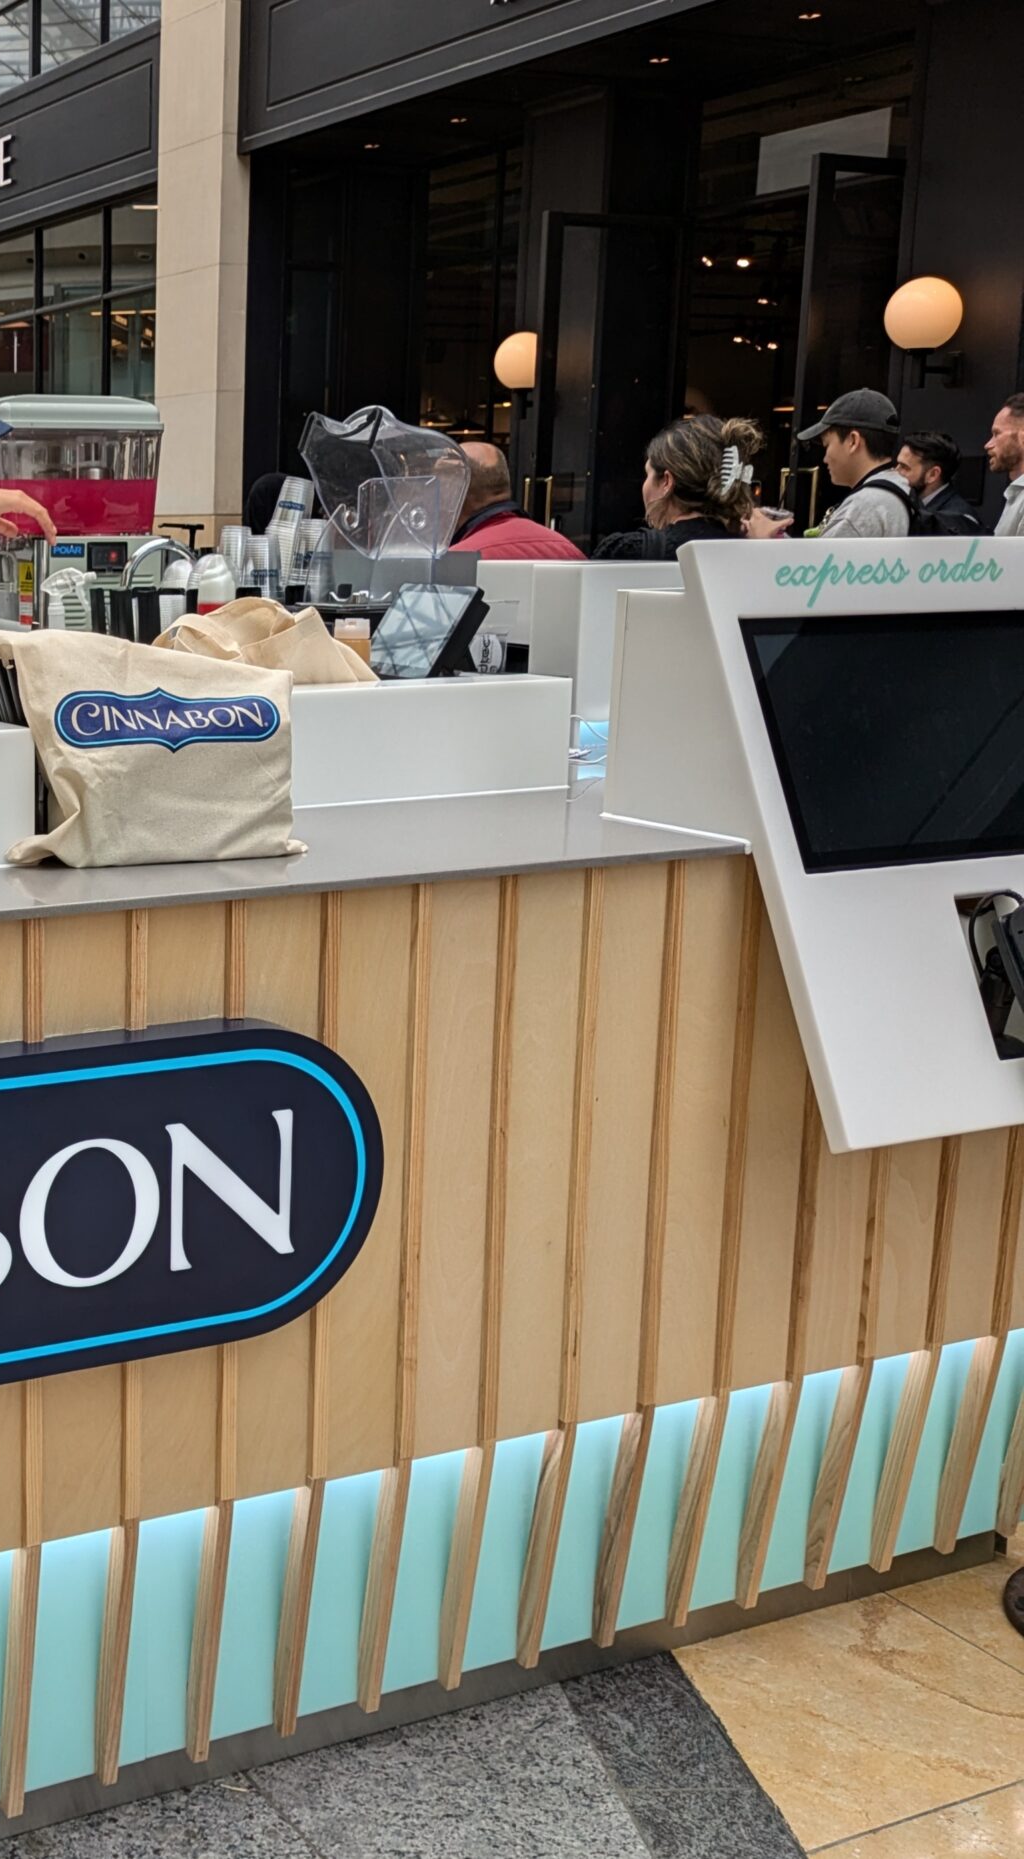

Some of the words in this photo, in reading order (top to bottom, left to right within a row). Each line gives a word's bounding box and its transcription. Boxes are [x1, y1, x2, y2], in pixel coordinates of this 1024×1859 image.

[53, 545, 83, 555] POLAR
[775, 553, 910, 608] express
[918, 539, 1004, 583] order
[71, 702, 265, 736] CINNABON
